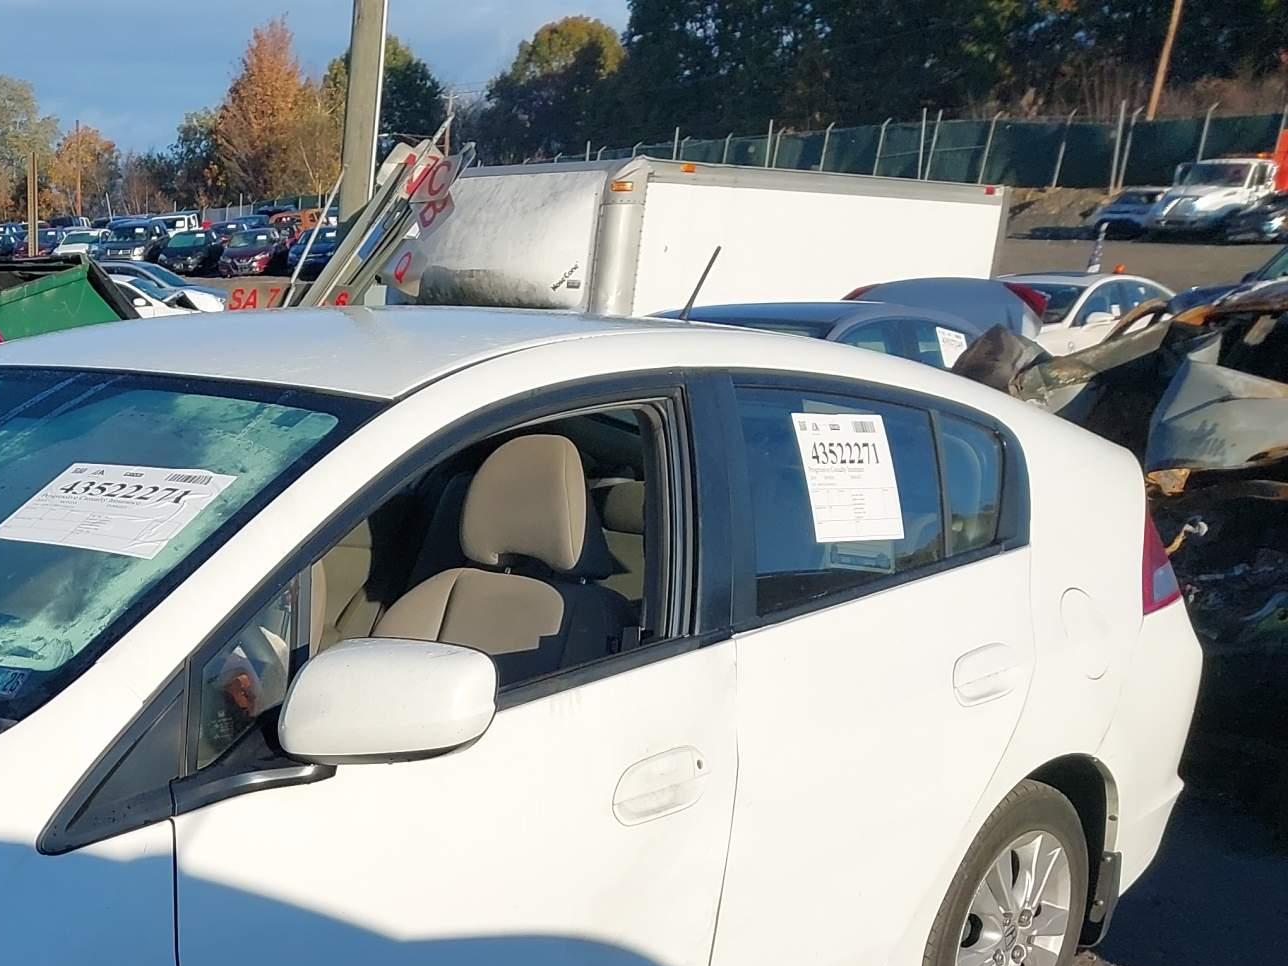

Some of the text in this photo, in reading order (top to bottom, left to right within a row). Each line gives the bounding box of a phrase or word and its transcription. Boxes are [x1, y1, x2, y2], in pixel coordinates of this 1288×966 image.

[228, 287, 257, 310] SA
[811, 441, 880, 465] 43522271
[59, 480, 192, 505] 43522271
